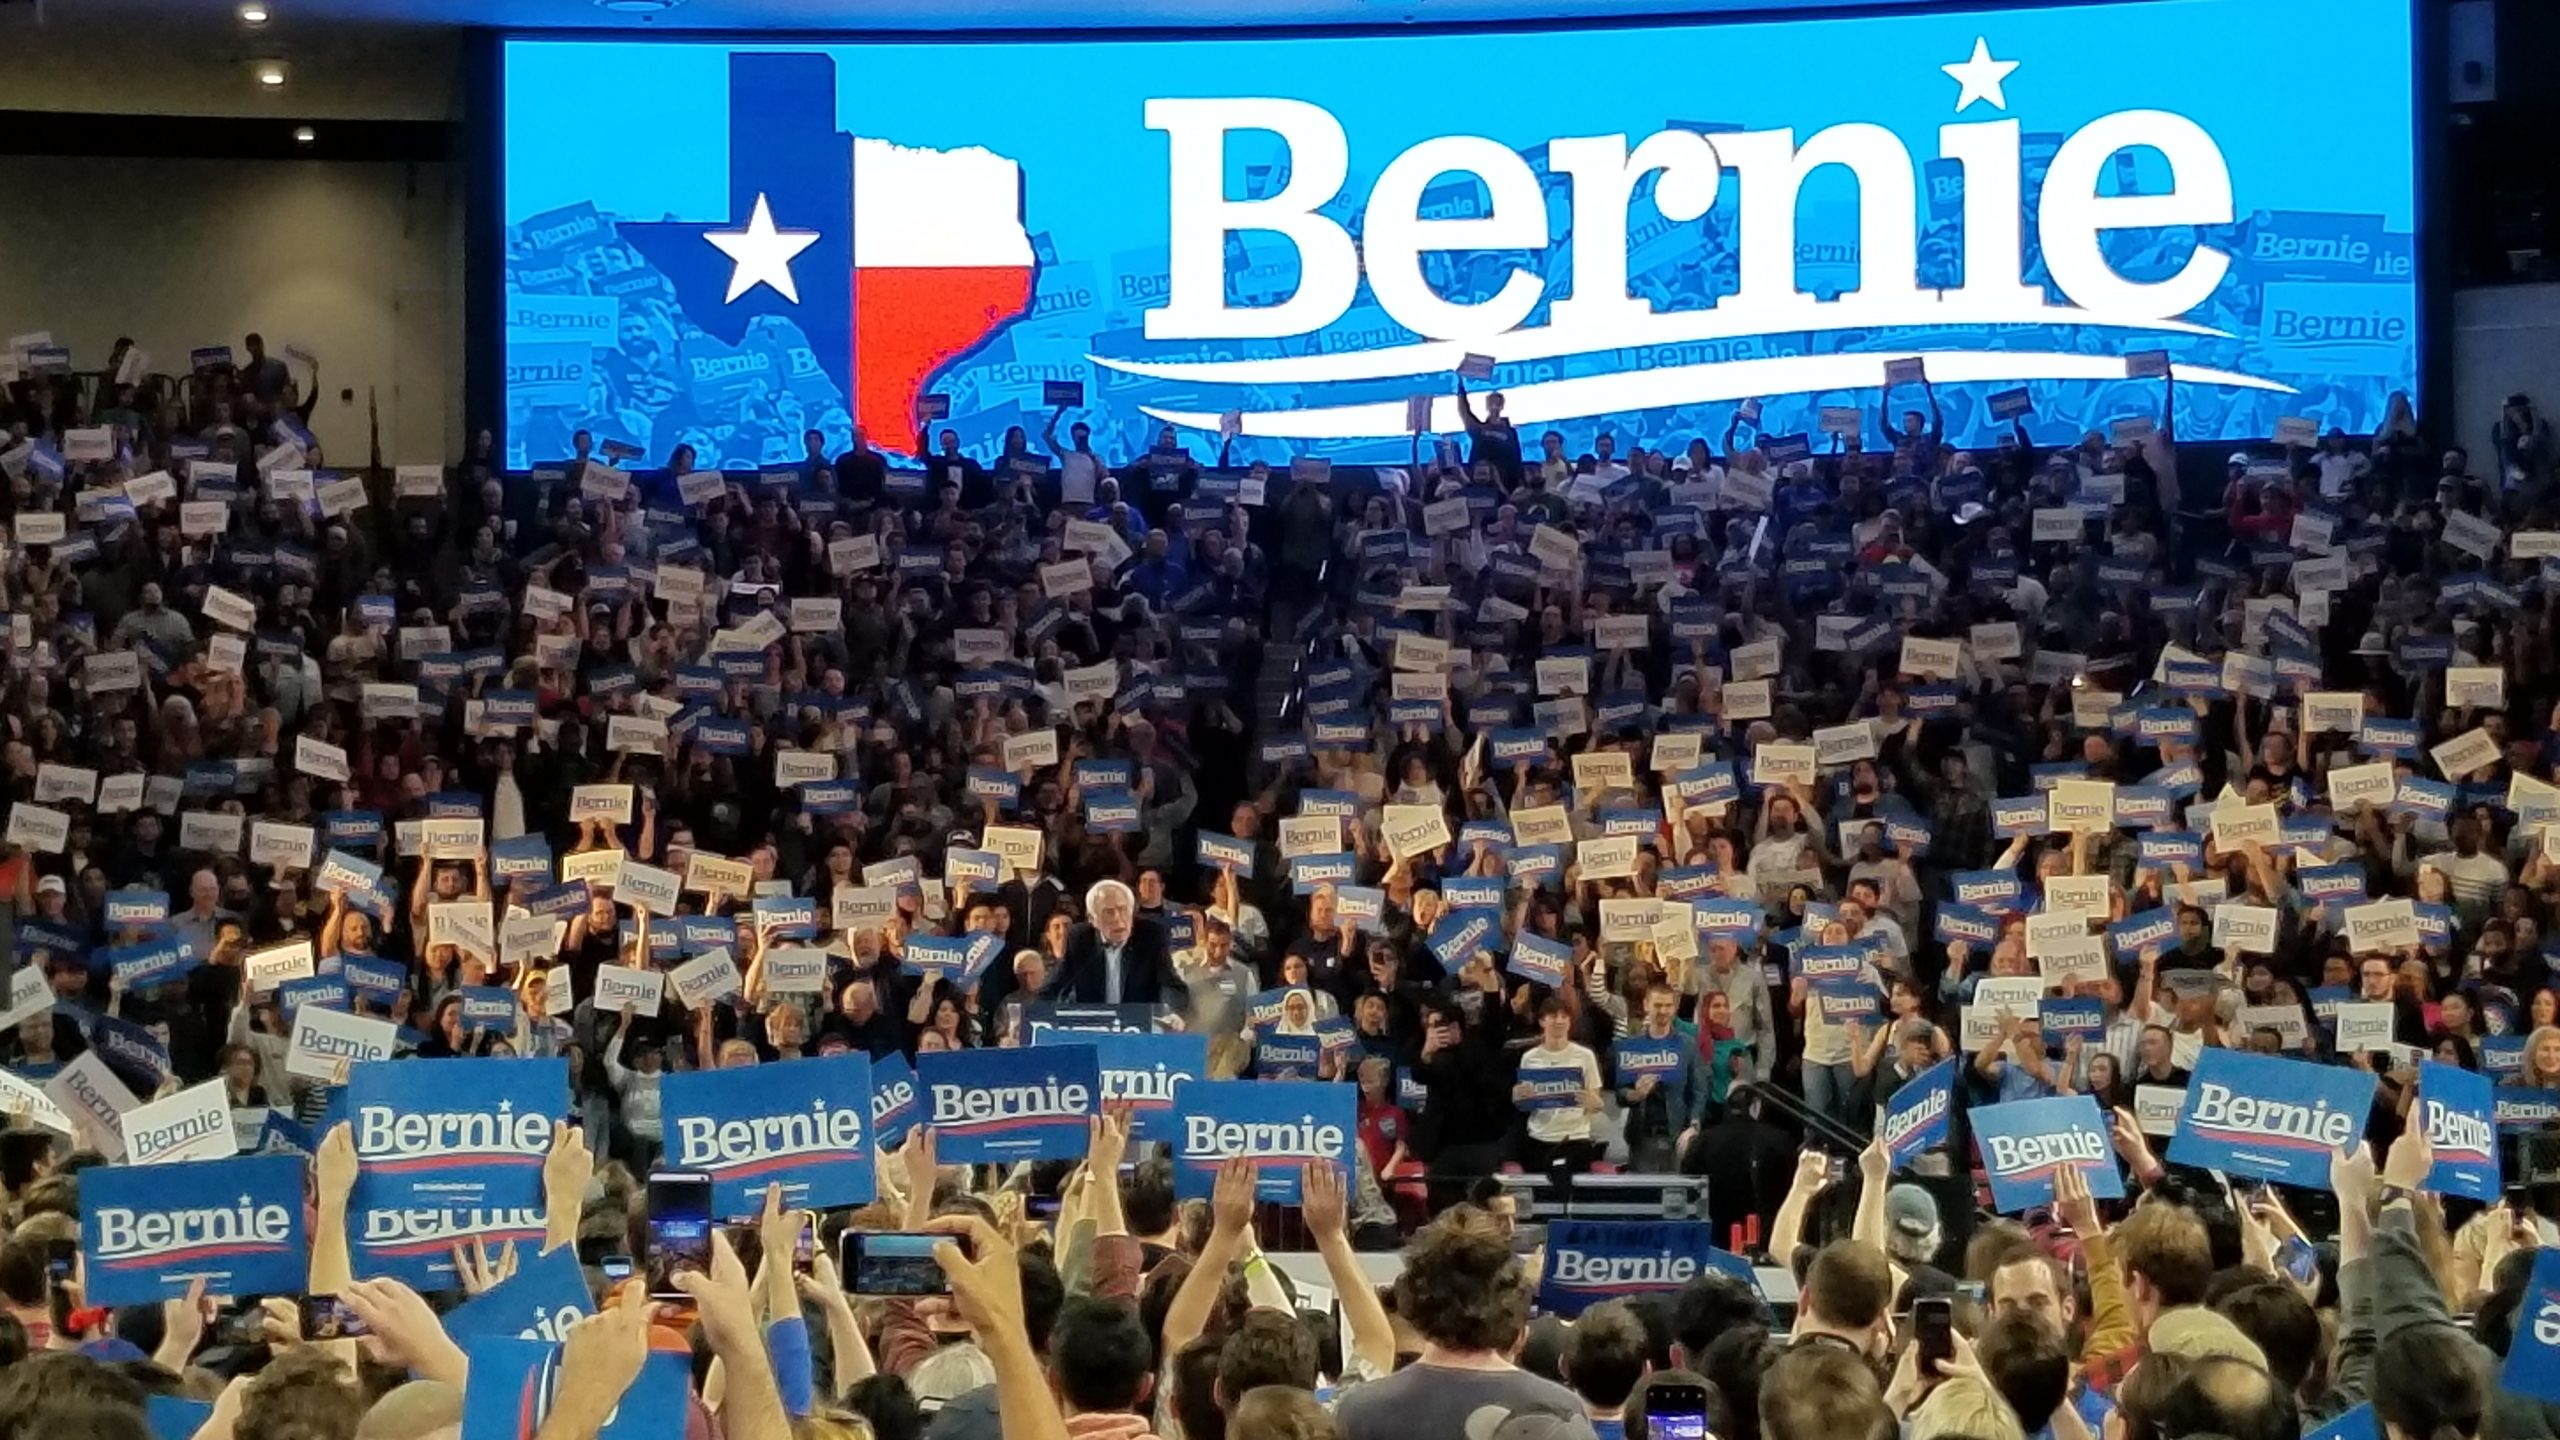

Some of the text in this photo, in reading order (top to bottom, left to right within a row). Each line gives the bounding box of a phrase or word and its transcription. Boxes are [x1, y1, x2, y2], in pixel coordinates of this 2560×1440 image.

[1143, 36, 2234, 342] Bernie
[2256, 233, 2368, 263] Bernie
[2273, 309, 2405, 343] Bernie
[689, 351, 768, 380] Bernie
[988, 361, 1085, 383] Bernie
[2363, 728, 2415, 744] Bernie
[1681, 773, 1731, 795] Bernie
[2335, 776, 2388, 791] Bernie
[2400, 786, 2447, 806] Bernie
[1285, 828, 1336, 844] Bernie
[323, 862, 372, 889] Bernie
[621, 874, 674, 896] Bernie
[693, 864, 746, 884] Bernie
[110, 903, 164, 917] Bernie
[757, 910, 811, 924] Bernie
[839, 901, 892, 914] Bernie
[1606, 912, 1659, 926] Bernie
[1696, 912, 1750, 926] Bernie
[1941, 915, 1993, 939] Bernie
[2218, 917, 2270, 936] Bernie
[2352, 913, 2410, 937] Bernie
[1438, 917, 1489, 961] Bernie
[2031, 922, 2082, 941] Bernie
[2115, 921, 2173, 948] Bernie
[117, 950, 177, 977] Bernie
[908, 946, 962, 962] Bernie
[1516, 943, 1564, 971] Bernie
[1802, 957, 1857, 973] Bernie
[2044, 951, 2100, 970] Bernie
[251, 957, 307, 977] Bernie
[347, 965, 399, 988] Bernie
[680, 961, 730, 995] Bernie
[768, 961, 822, 976] Bernie
[601, 978, 656, 1000] Bernie
[1979, 988, 2037, 1002] Bernie
[2043, 1011, 2101, 1029] Bernie
[2343, 1018, 2388, 1033] Bernie
[299, 1025, 383, 1063] Bernie
[1619, 1051, 1678, 1068] Bernie
[929, 1074, 1088, 1122] Bernie
[2496, 1100, 2557, 1118] Bernie
[1885, 1088, 1947, 1142] Bernie
[2193, 1082, 2352, 1145] Bernie
[134, 1108, 223, 1157] Bernie
[359, 1099, 550, 1154] Bernie
[678, 1098, 861, 1165] Bernie
[1184, 1114, 1344, 1157] Bernie
[2427, 1100, 2492, 1155] Bernie
[1989, 1124, 2105, 1172] Bernie
[96, 1192, 290, 1254] Bernie
[1553, 1247, 1697, 1283] Bernie
